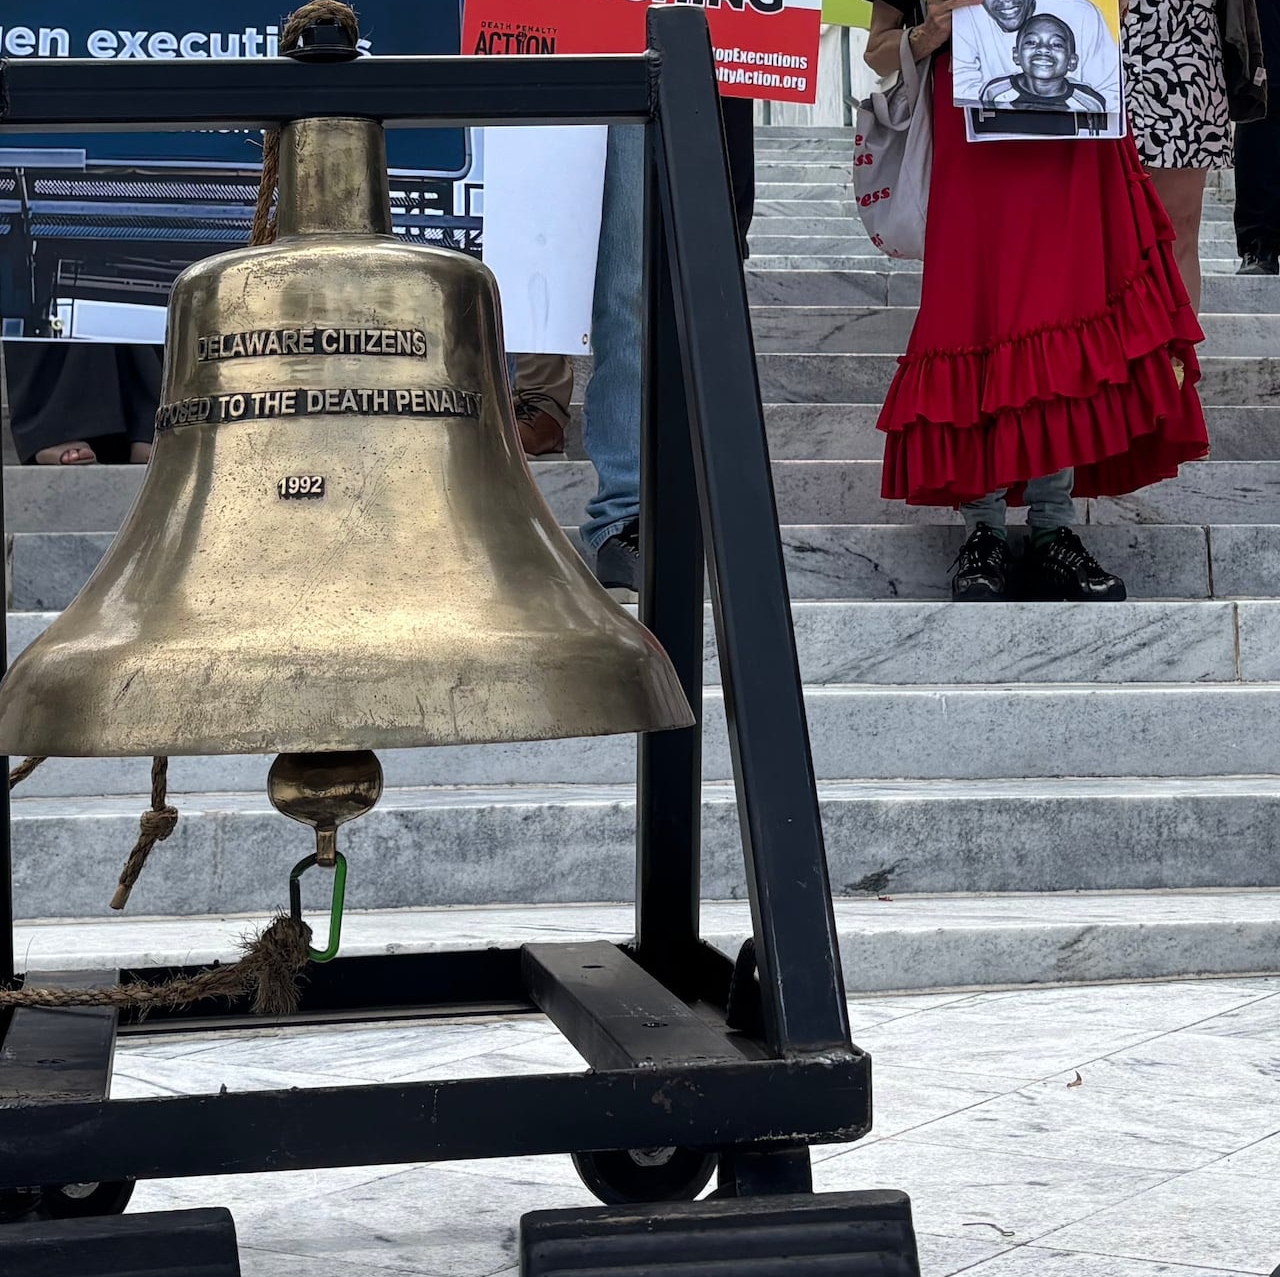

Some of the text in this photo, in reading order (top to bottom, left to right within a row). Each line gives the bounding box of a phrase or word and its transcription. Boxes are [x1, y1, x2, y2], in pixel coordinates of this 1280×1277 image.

[481, 20, 558, 34] DEATH PENALTY
[197, 328, 427, 361] DELAWARE CITIZENS
[219, 395, 245, 420] TO
[251, 390, 296, 416] THE
[307, 389, 389, 414] DEATH
[395, 389, 483, 417] PENALTY
[277, 476, 324, 496] 1992
